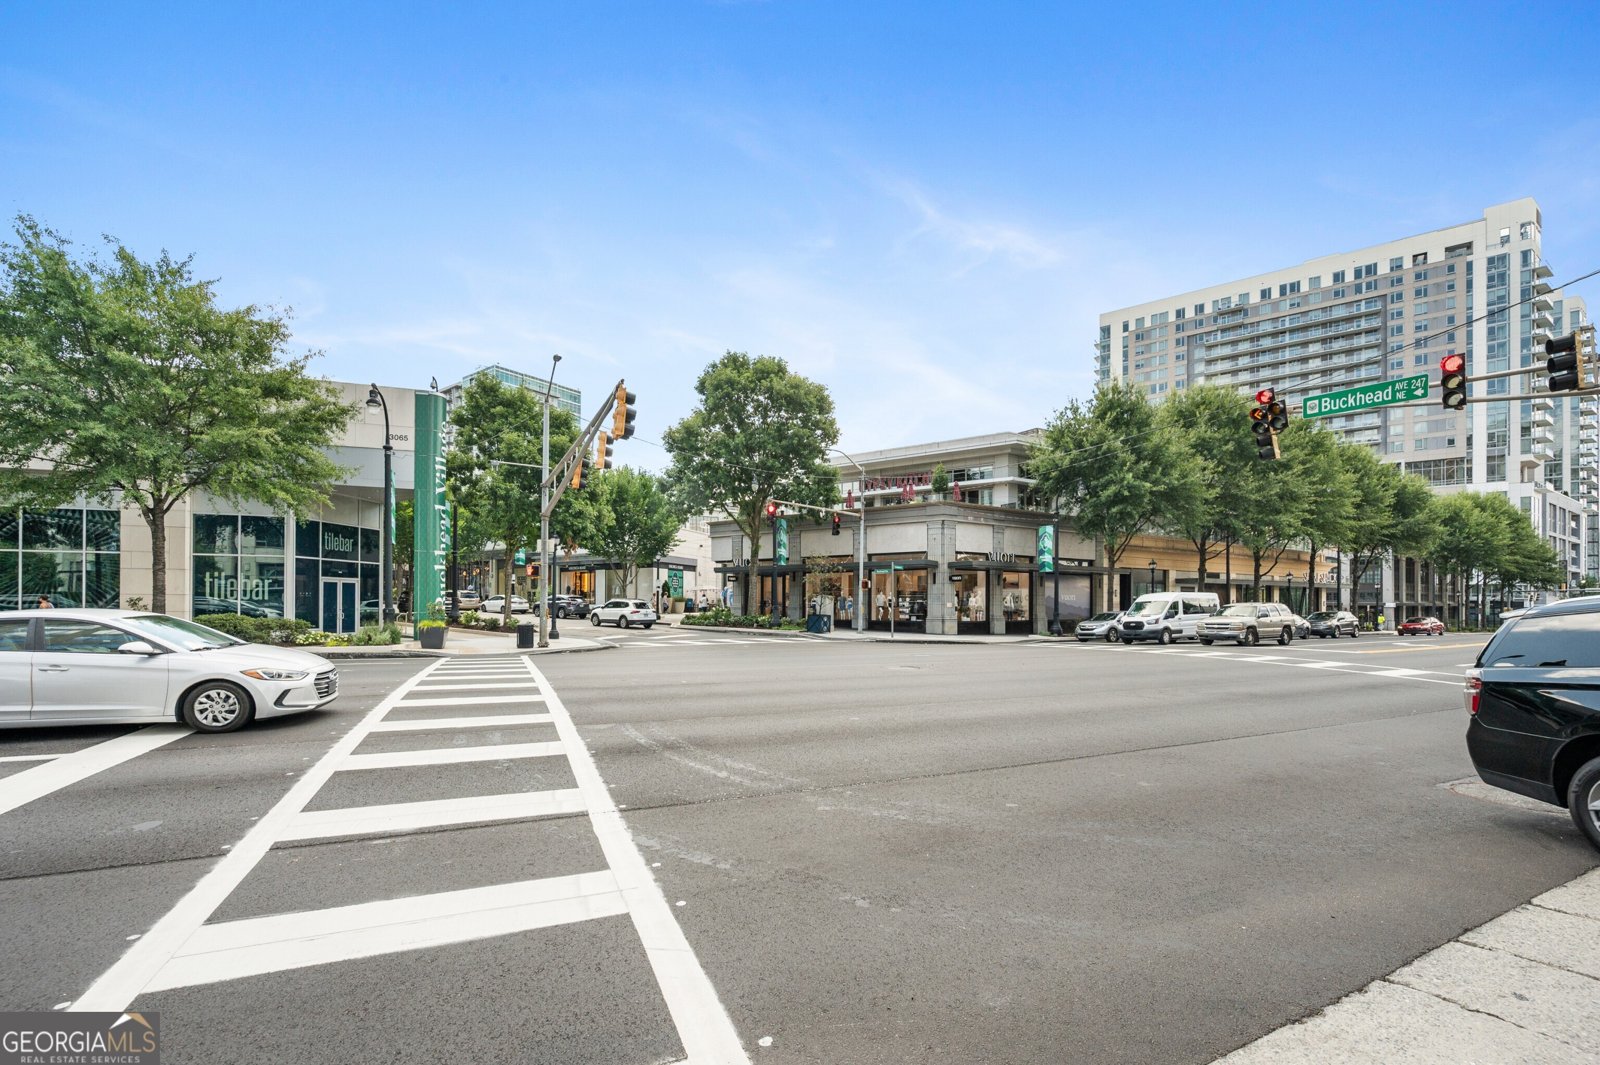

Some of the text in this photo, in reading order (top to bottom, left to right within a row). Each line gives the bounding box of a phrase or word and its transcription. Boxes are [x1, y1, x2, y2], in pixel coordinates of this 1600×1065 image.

[1321, 378, 1426, 412] Buckhead AVE 247
[1396, 391, 1407, 400] NE
[388, 433, 409, 442] 3065
[324, 531, 354, 552] tilebar
[733, 558, 751, 568] vuo
[204, 571, 273, 601] tilebar
